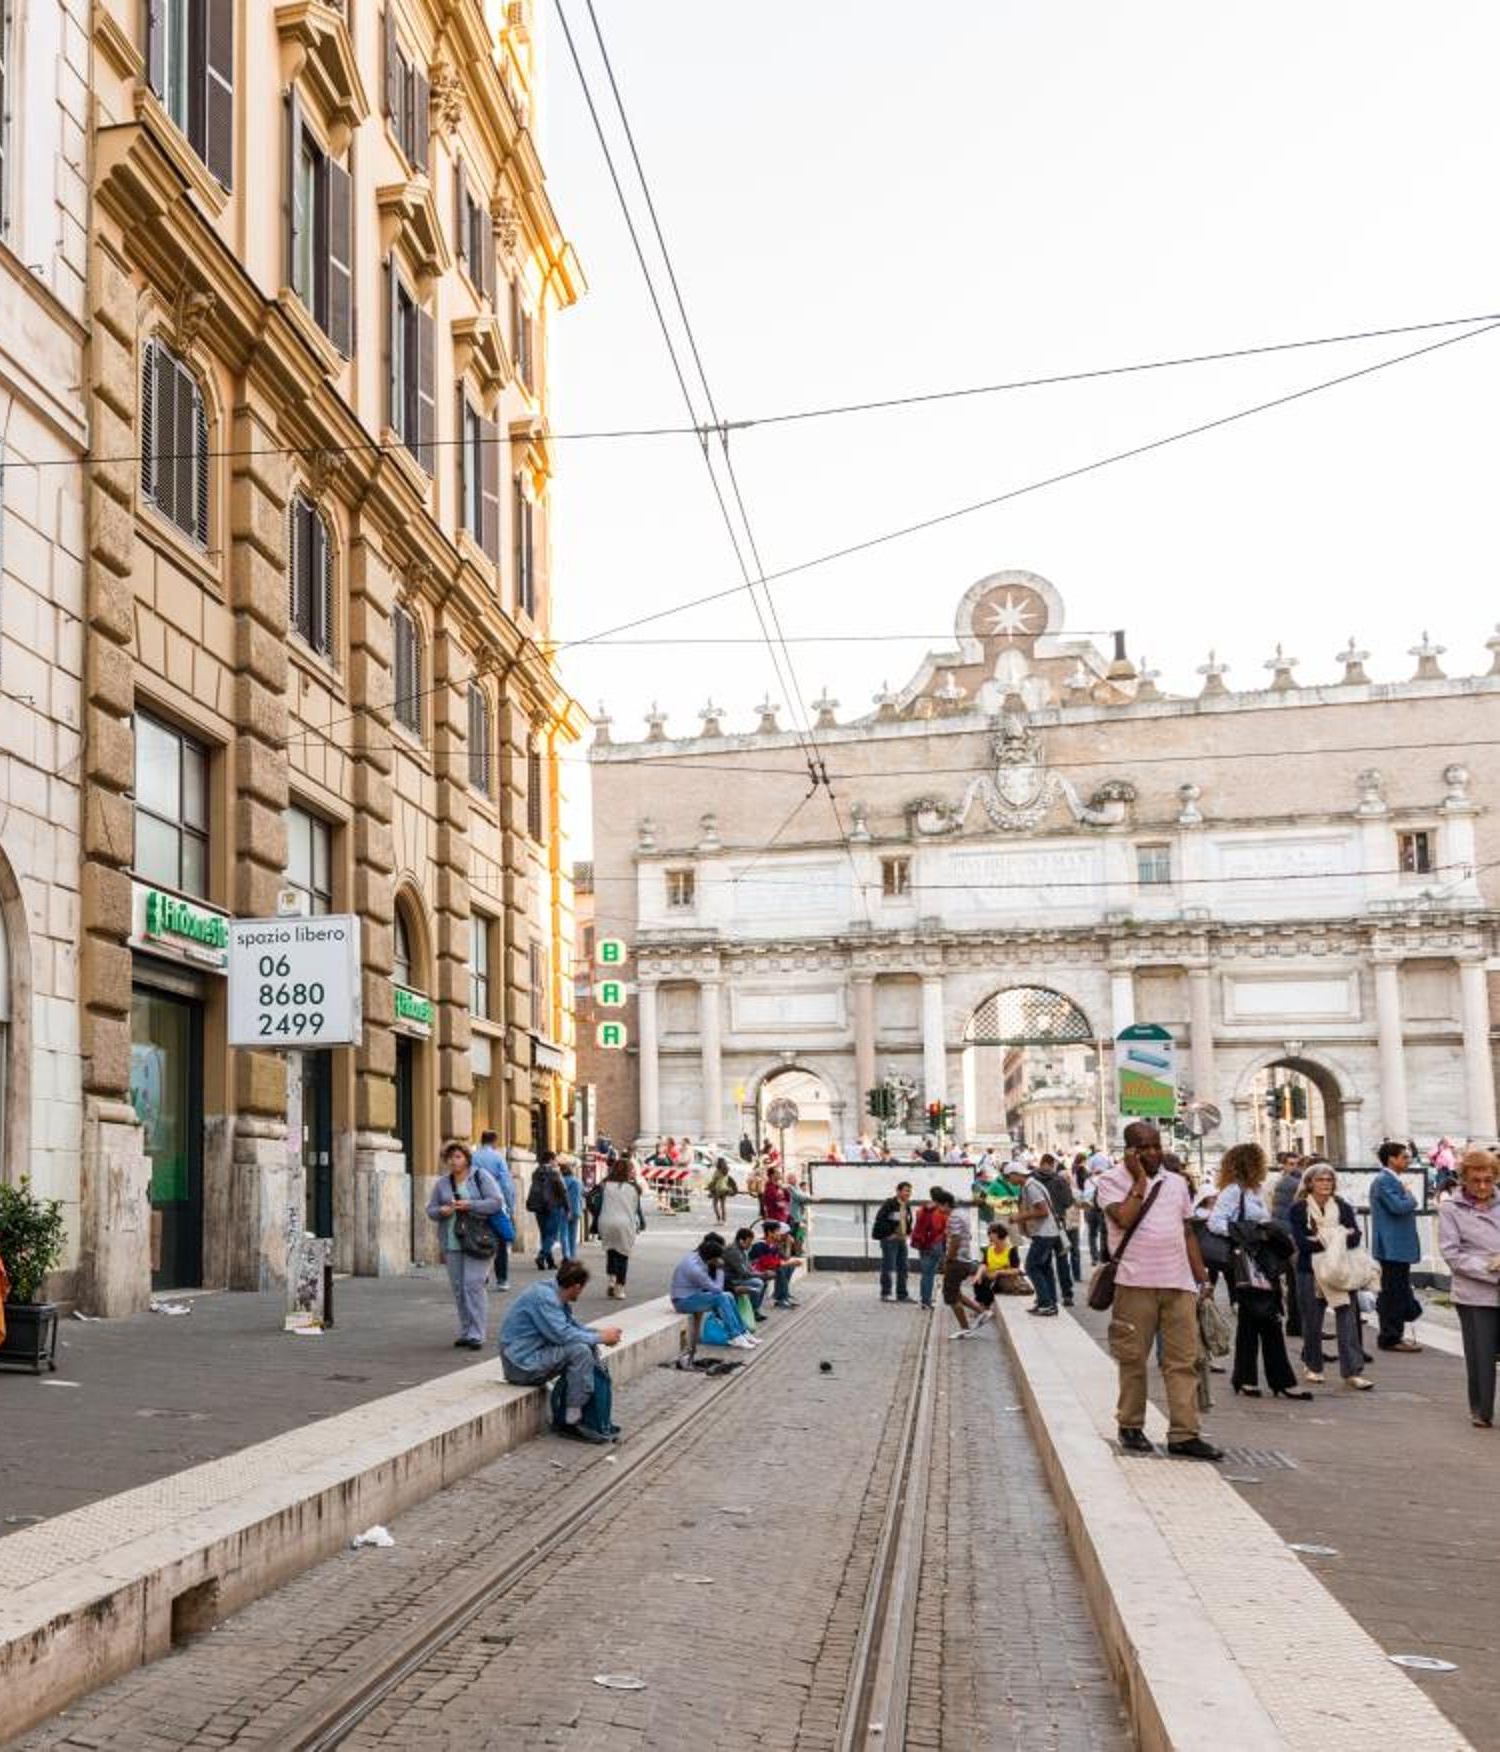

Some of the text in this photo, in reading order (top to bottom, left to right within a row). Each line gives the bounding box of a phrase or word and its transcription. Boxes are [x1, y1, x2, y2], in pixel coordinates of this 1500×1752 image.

[237, 926, 345, 949] spazio libero
[259, 954, 291, 977] 06
[259, 982, 325, 1006] 8680
[259, 1013, 325, 1036] 2499
